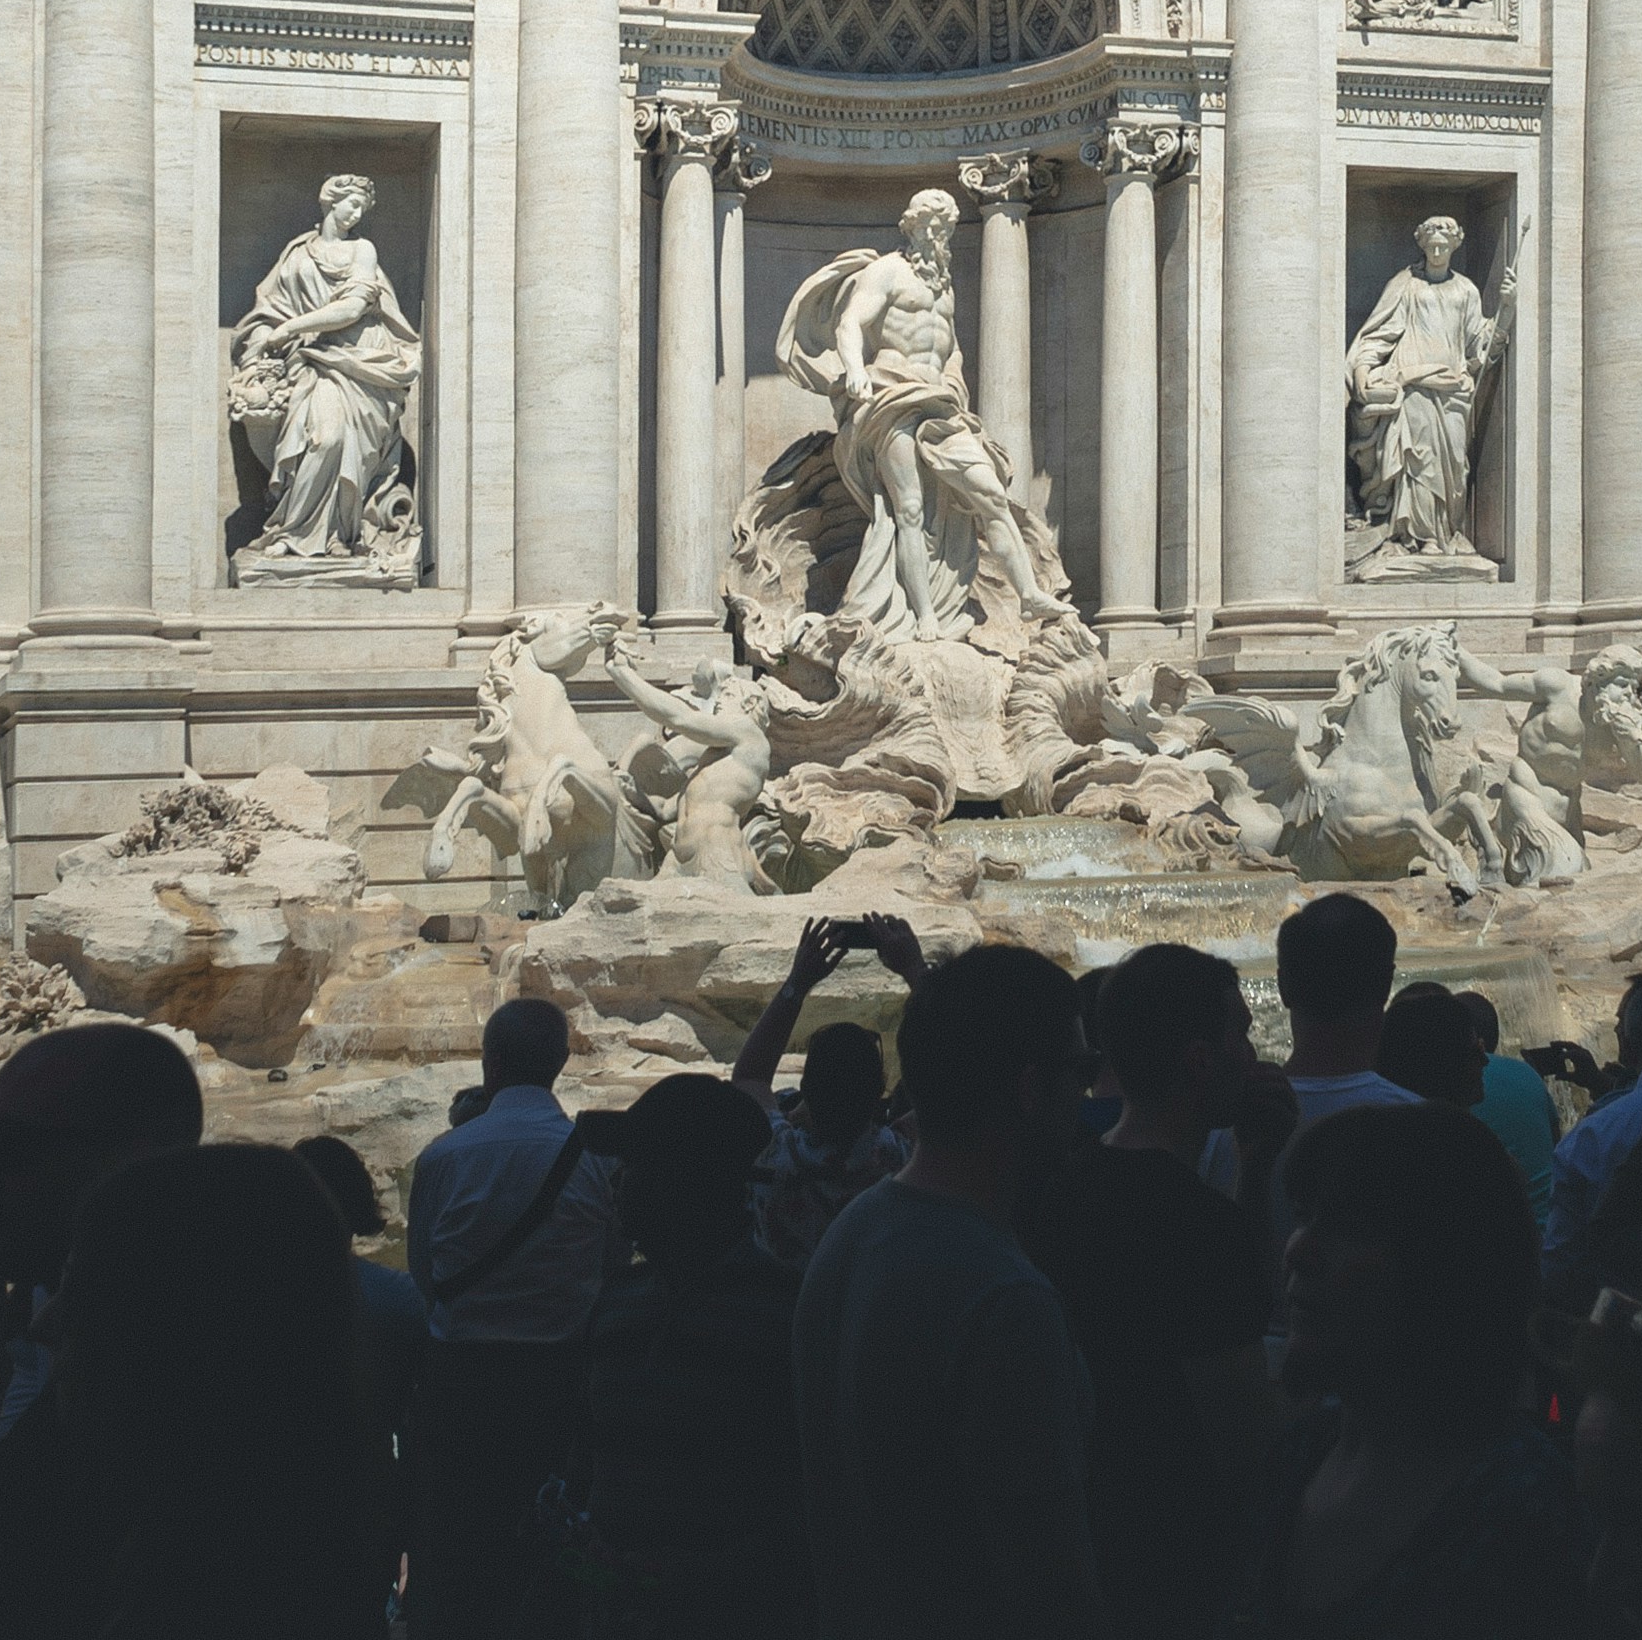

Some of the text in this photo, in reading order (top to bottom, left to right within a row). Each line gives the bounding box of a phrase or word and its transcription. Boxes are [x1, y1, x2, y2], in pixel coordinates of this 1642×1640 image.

[196, 44, 463, 77] POSITIS SIGNIS ET ANA
[1020, 113, 1061, 137] OPVS
[1067, 102, 1099, 125] CVM
